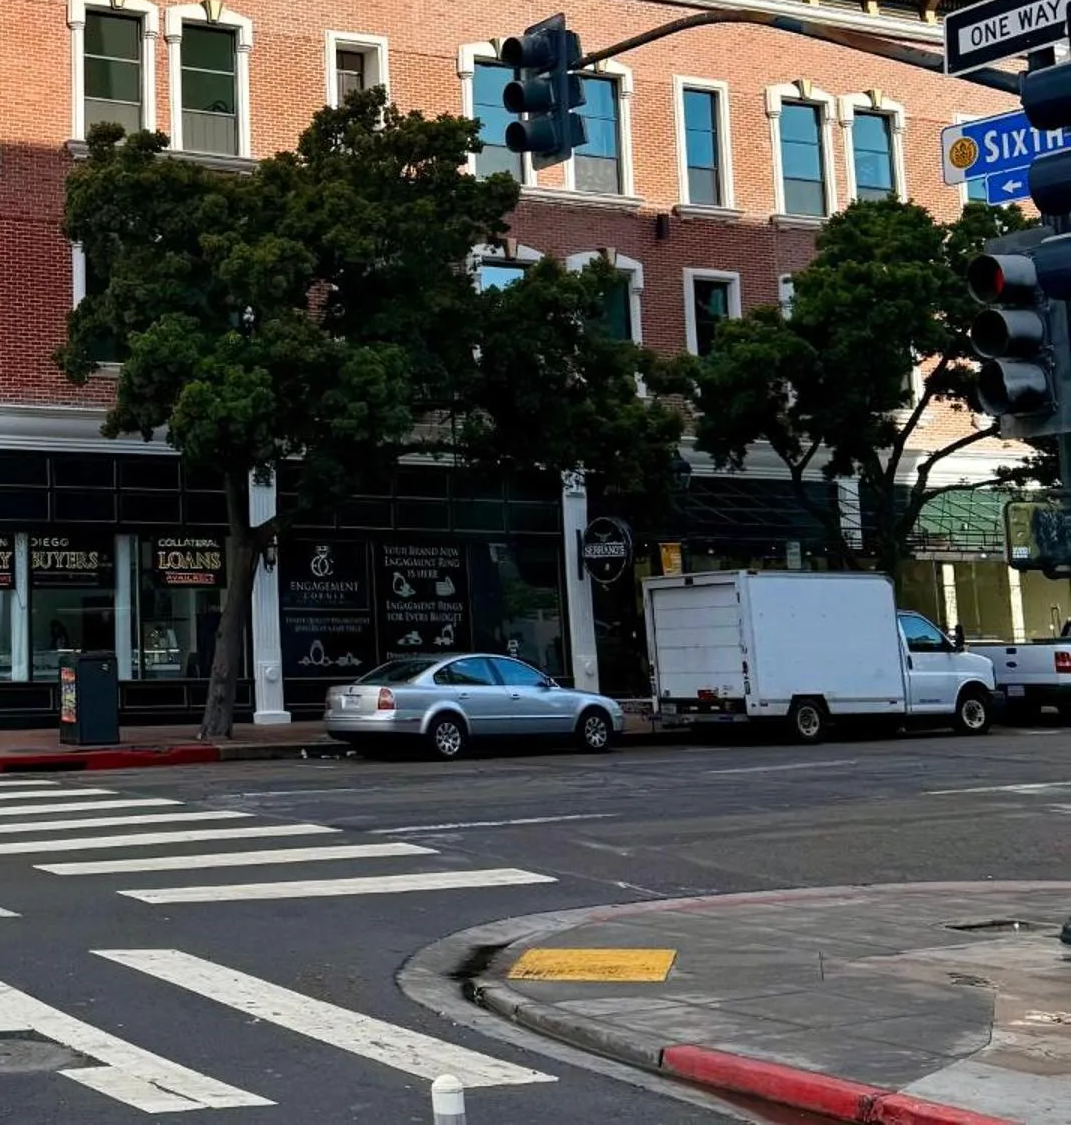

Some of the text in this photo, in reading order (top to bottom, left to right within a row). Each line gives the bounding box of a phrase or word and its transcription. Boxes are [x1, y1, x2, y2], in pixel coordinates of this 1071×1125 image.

[971, 16, 1010, 46] ONE
[30, 537, 69, 547] DIEGO
[31, 550, 99, 570] BUYERS
[157, 551, 221, 570] LOANS
[290, 581, 359, 592] ENGAGEMENT
